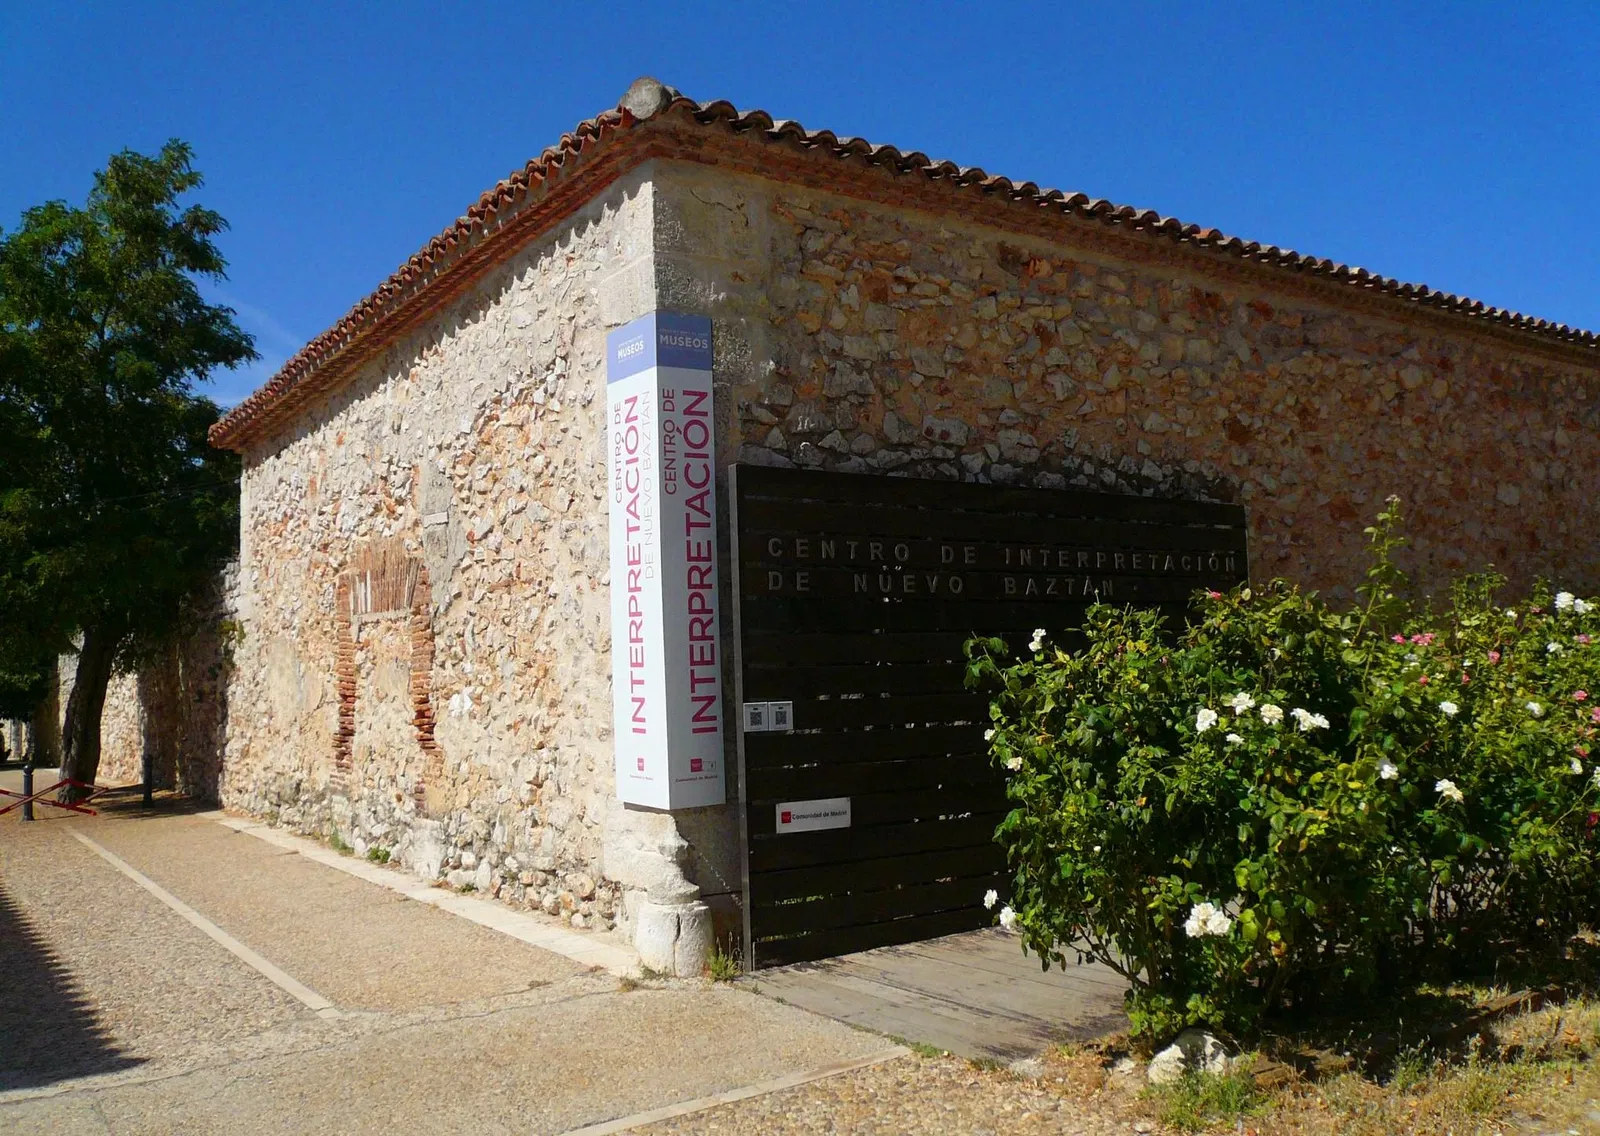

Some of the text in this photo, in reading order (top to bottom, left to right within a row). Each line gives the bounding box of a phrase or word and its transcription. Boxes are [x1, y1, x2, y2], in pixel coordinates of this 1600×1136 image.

[617, 340, 644, 359] MUSEOS
[659, 334, 708, 349] MUSEOS
[613, 401, 623, 503] CENTRO DE
[662, 388, 677, 495] CENTRO DE
[642, 478, 653, 546] NUEVO
[622, 395, 646, 734] INTERPRETACIÓN
[645, 554, 654, 578] DE
[676, 389, 718, 734] INTERPRETACIÓN
[767, 537, 1236, 572] CENTRO DE INTERPRETACIÓN
[768, 571, 1114, 596] DE NUEVO BAZTÁN
[792, 812, 821, 820] Comunidad
